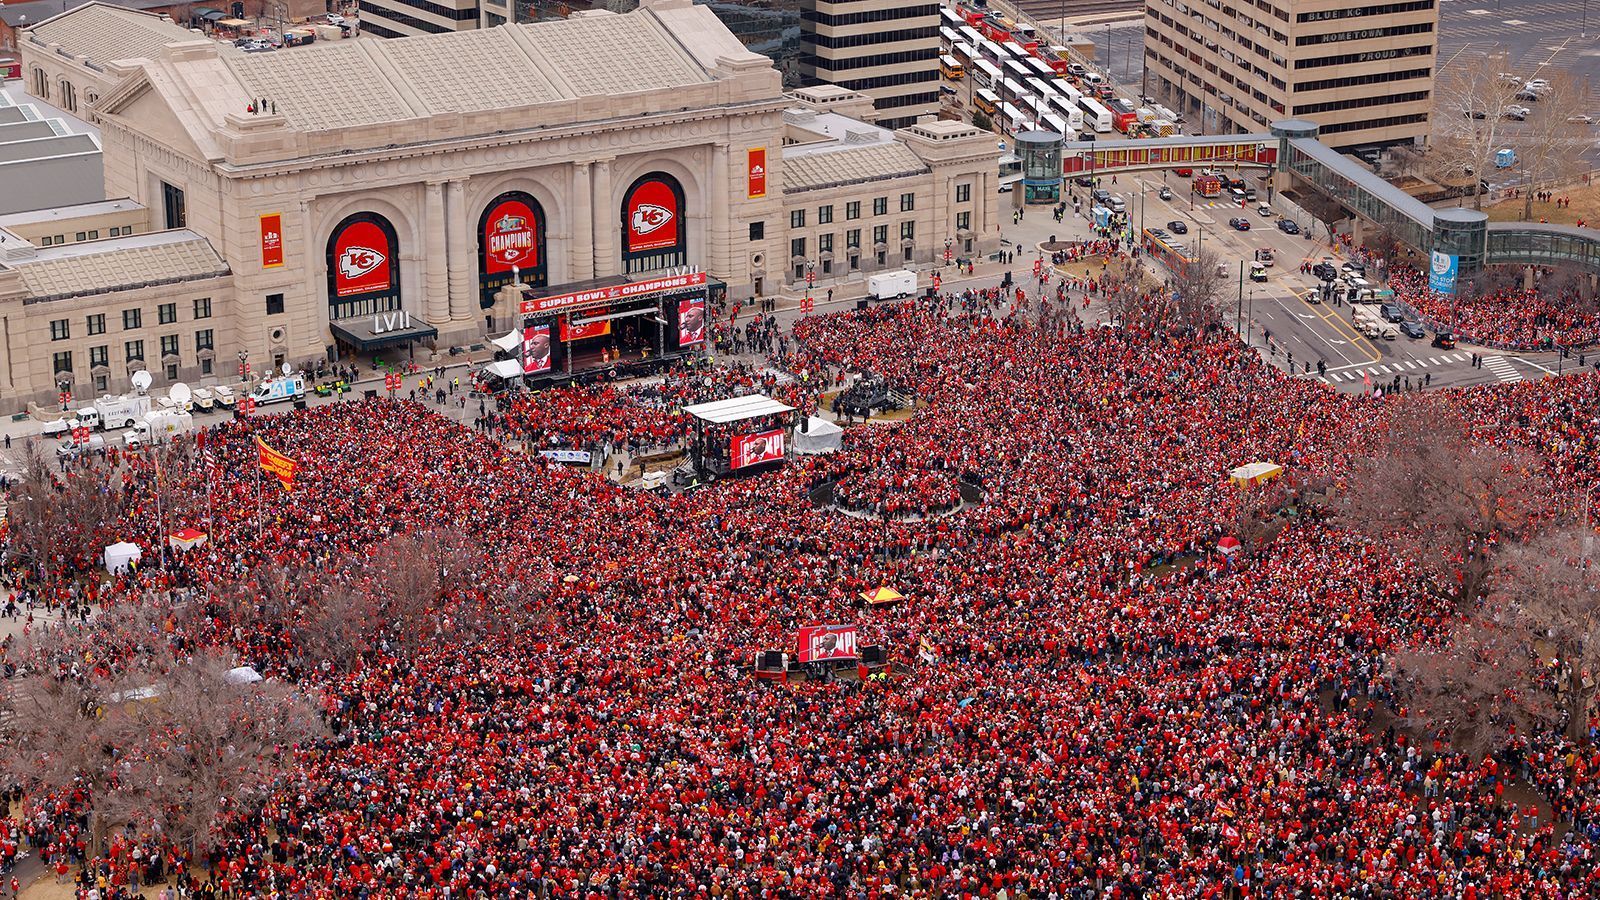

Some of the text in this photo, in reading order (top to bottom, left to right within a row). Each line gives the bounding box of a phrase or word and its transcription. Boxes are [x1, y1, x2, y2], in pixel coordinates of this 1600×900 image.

[1309, 8, 1362, 21] BLUE KC
[1322, 29, 1384, 43] HOMETOWN
[1360, 50, 1397, 62] PROUD
[1096, 145, 1254, 165] WORLD CHAMPIONS
[642, 209, 663, 226] KC
[491, 231, 532, 253] CHAMPIONS
[350, 252, 374, 269] KC
[540, 296, 574, 309] SUPER
[576, 291, 606, 302] BOWL
[622, 277, 688, 295] CHAMPIONS
[375, 310, 410, 334] LVII
[267, 452, 294, 471] CHIEFS
